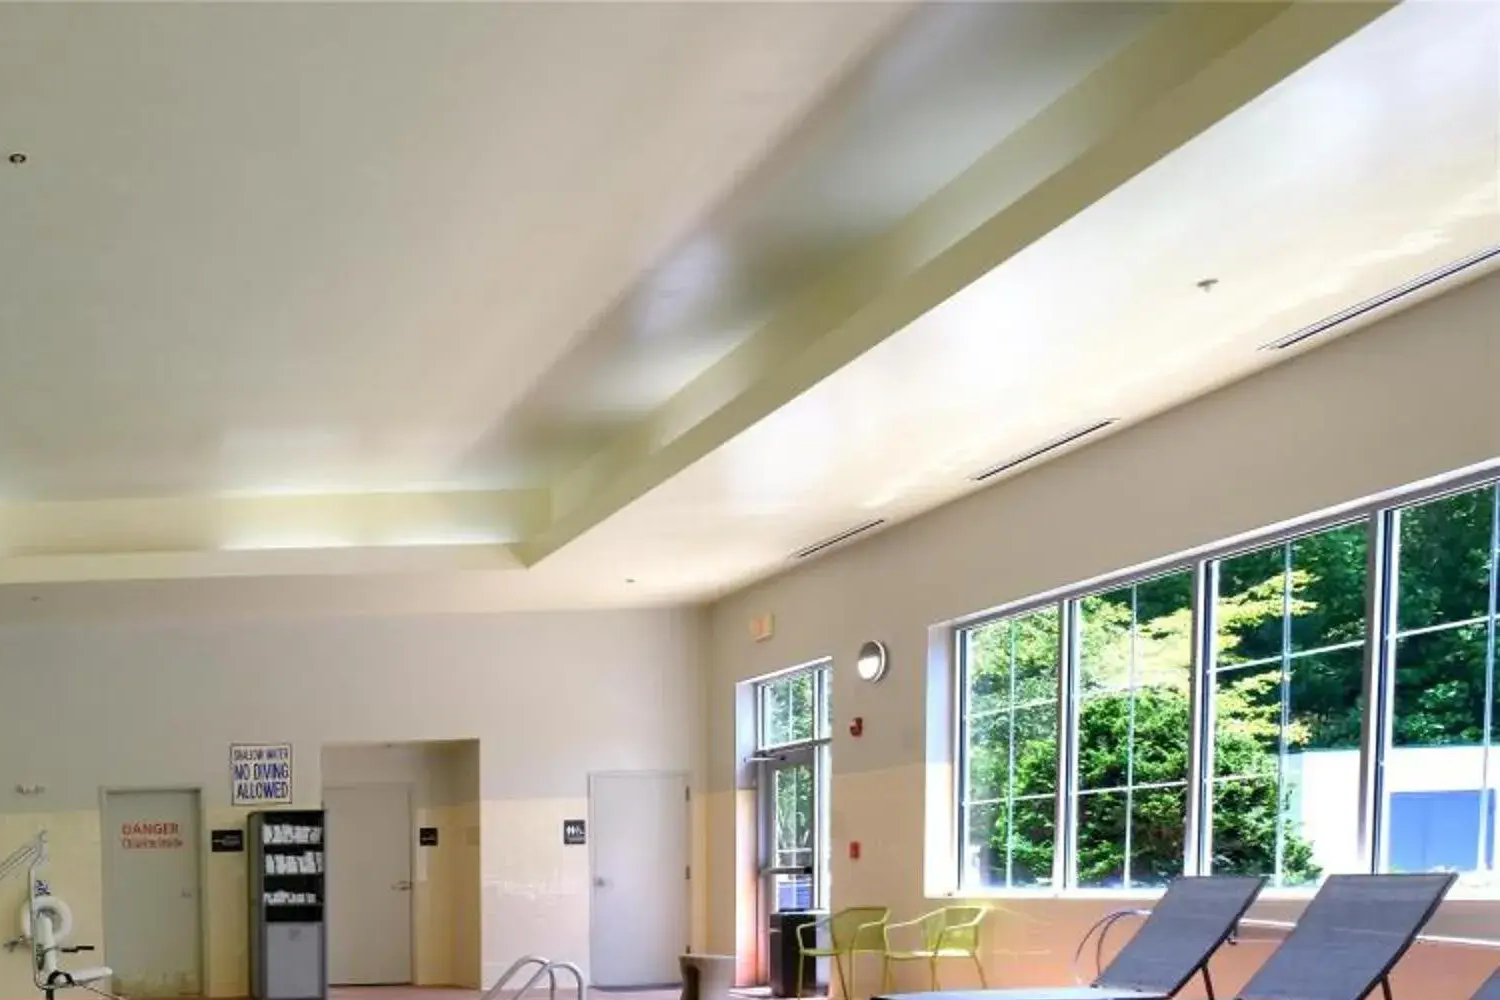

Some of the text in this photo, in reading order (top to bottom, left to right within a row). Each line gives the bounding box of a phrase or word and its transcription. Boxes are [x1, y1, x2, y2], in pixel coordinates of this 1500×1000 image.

[234, 762, 289, 780] NO DIVING
[236, 781, 289, 799] ALLOWED
[121, 822, 179, 836] DANGER
